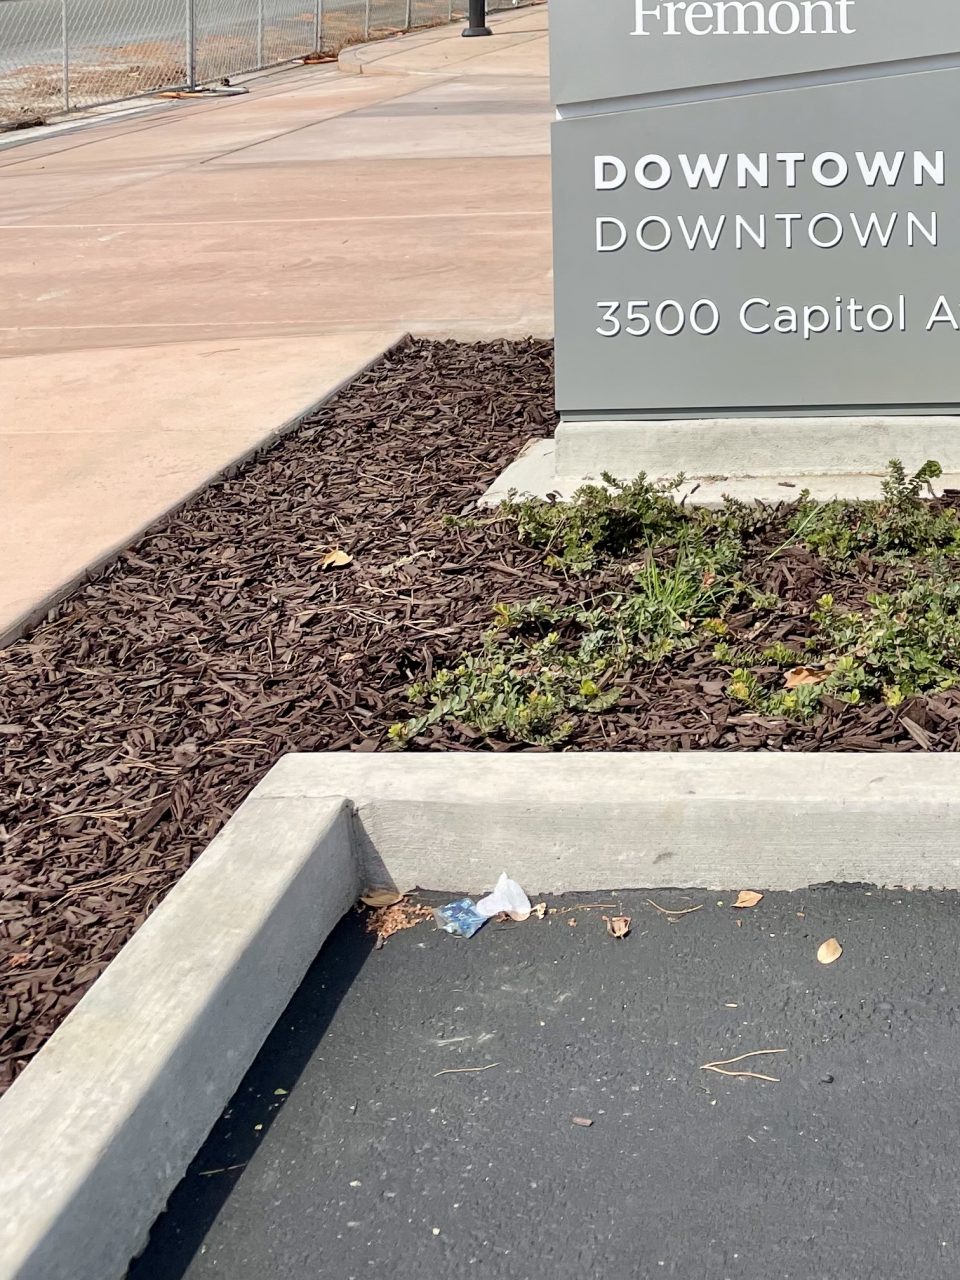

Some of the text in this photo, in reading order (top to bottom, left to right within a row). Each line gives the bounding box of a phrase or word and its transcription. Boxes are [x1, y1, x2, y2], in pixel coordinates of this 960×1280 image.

[594, 150, 946, 192] DOWNTOWN
[595, 211, 938, 253] DOWNTOWN
[595, 298, 720, 338] 3500
[739, 294, 907, 341] Capitol
